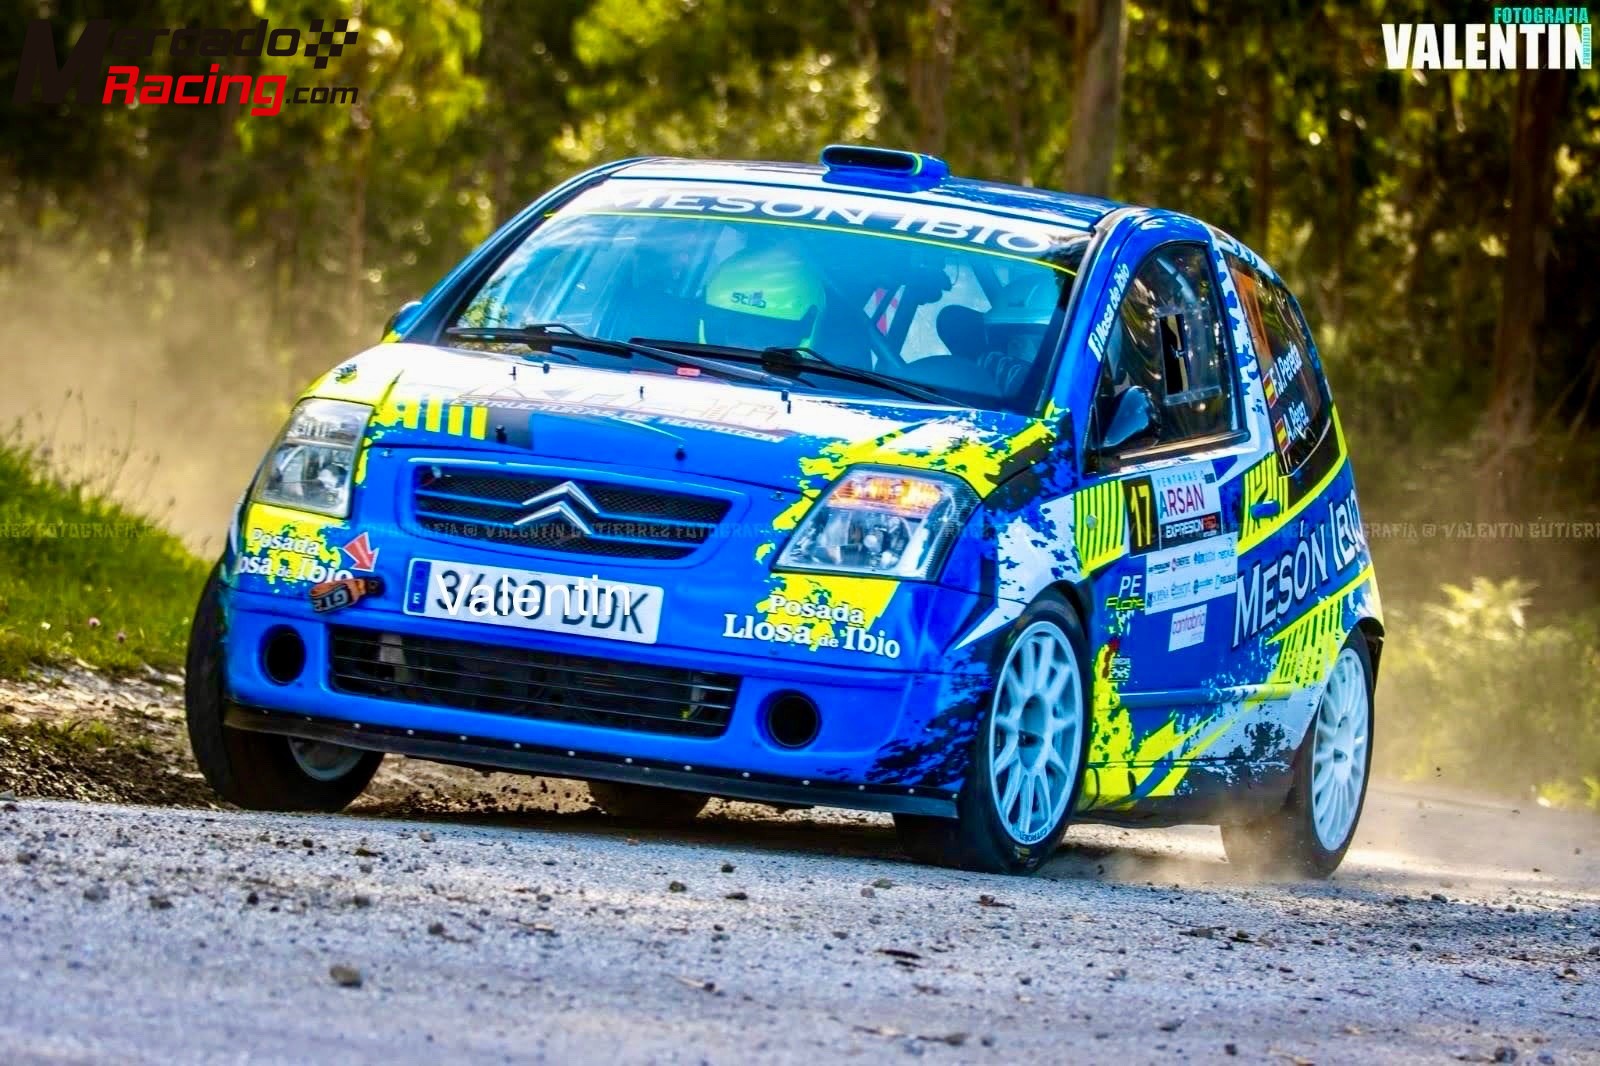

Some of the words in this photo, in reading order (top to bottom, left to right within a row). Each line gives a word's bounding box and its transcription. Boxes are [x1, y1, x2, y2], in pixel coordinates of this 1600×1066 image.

[1130, 484, 1152, 547] 17
[1159, 483, 1205, 519] ARSAN
[252, 527, 318, 556] Posada
[1231, 519, 1329, 648] MESÓN
[768, 593, 866, 626] Posada
[722, 612, 812, 646] Llosa
[818, 634, 840, 649] de
[843, 624, 901, 660] Ibio
